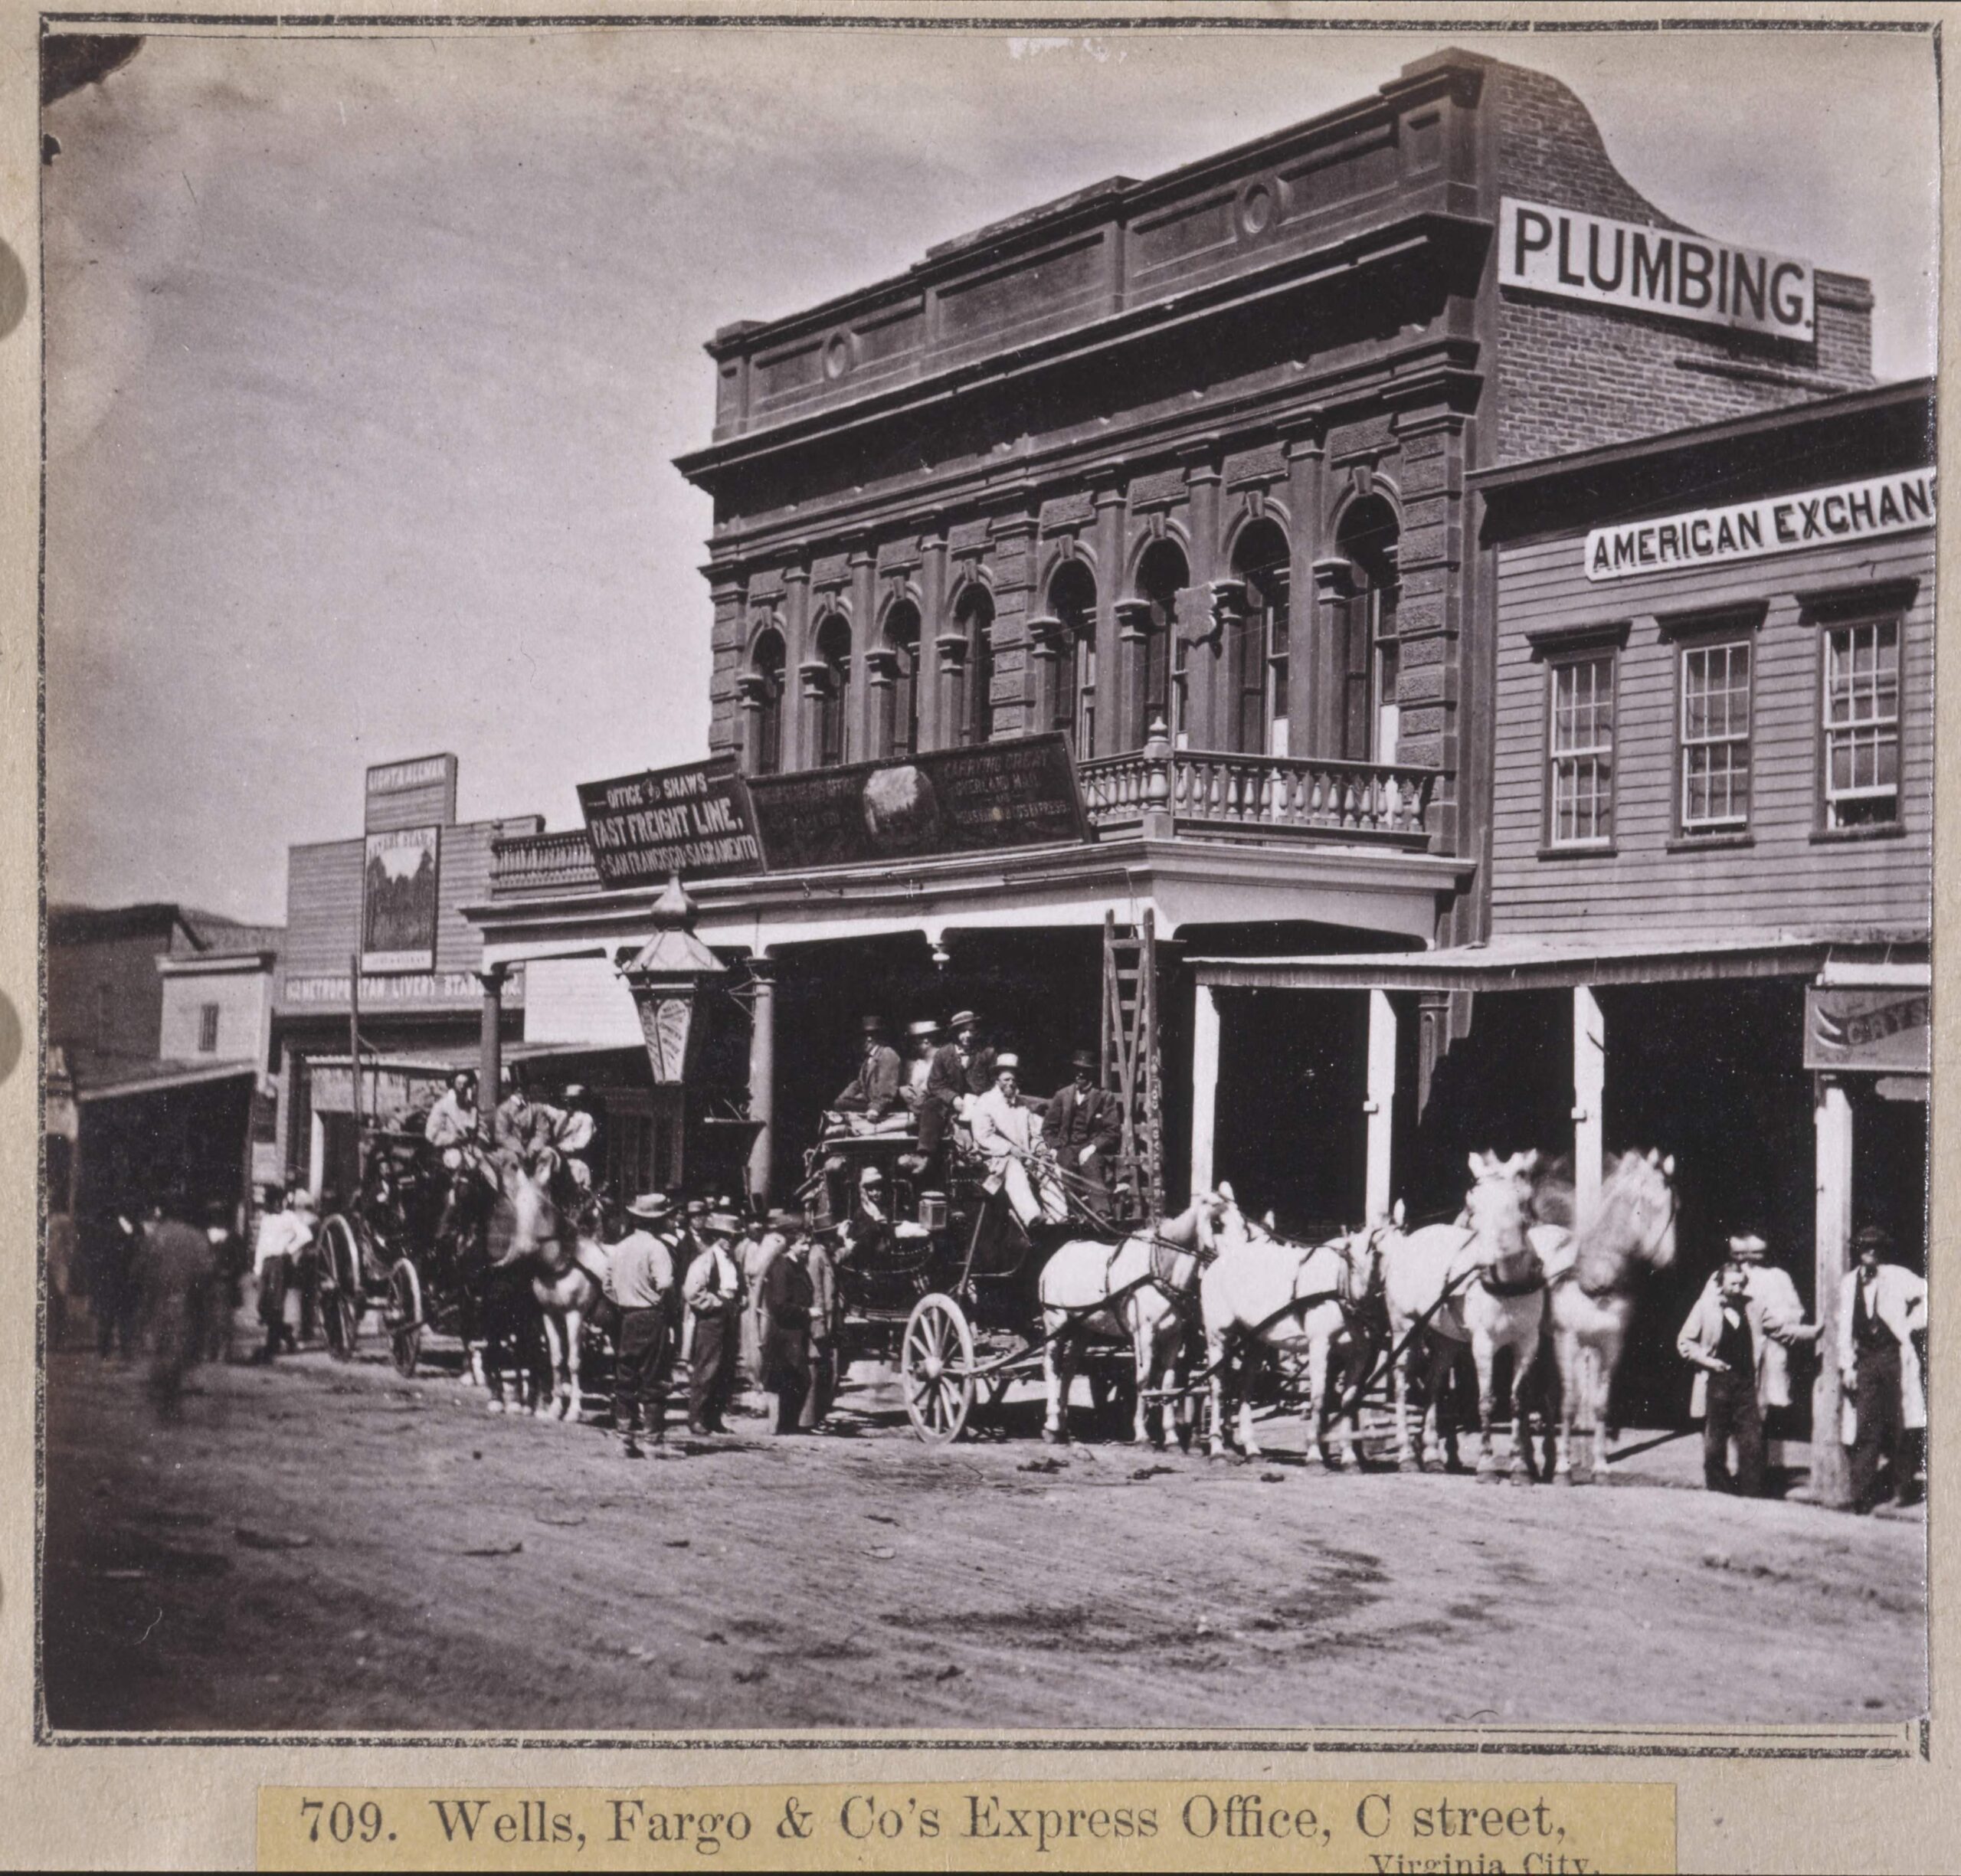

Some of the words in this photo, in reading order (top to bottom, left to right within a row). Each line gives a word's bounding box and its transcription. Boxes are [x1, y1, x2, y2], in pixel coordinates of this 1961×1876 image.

[1514, 207, 1814, 329] PLUMBING.
[1593, 510, 1764, 572] AMERICAN
[606, 784, 643, 808] OFFICE
[591, 815, 628, 850] FAST
[627, 804, 690, 844] FREIGHT
[605, 852, 631, 878] SAN
[625, 844, 687, 876] FRANCISCO
[685, 833, 759, 867] SACRAMENTO
